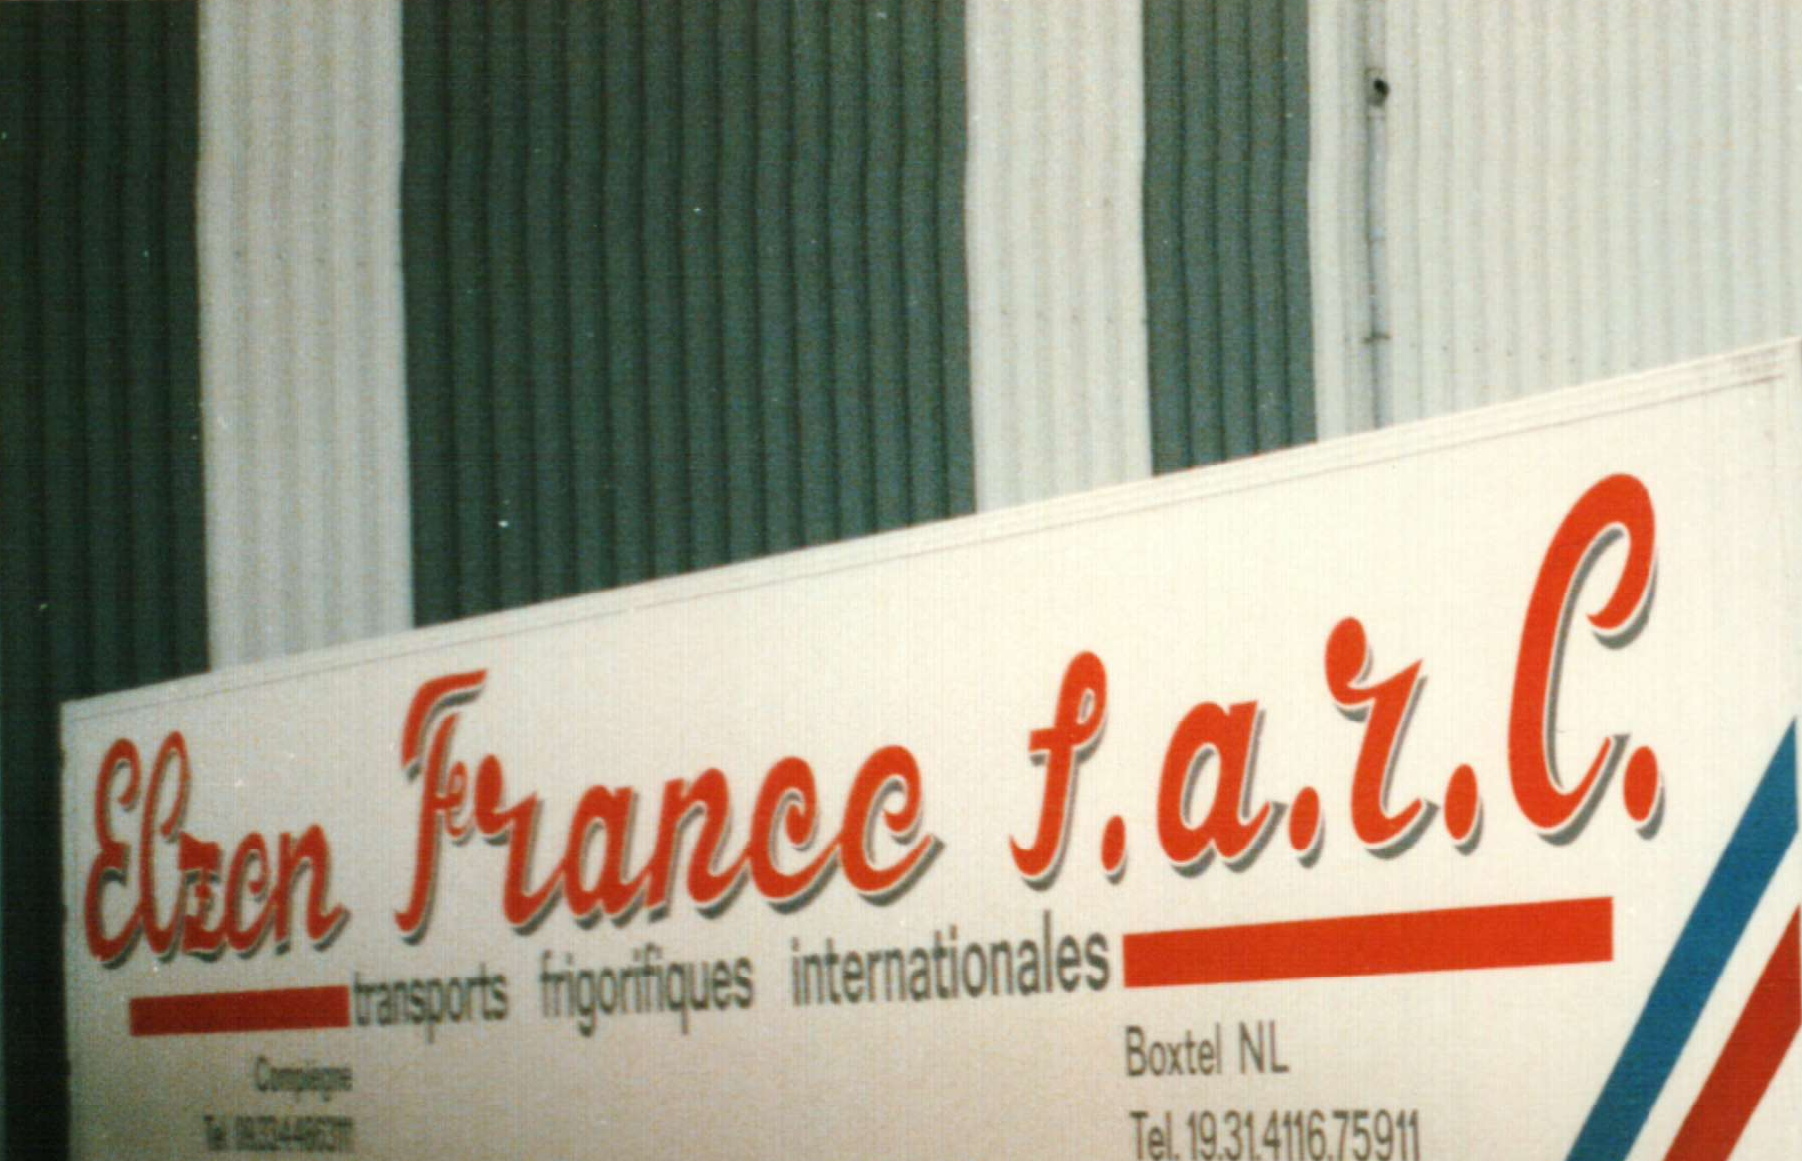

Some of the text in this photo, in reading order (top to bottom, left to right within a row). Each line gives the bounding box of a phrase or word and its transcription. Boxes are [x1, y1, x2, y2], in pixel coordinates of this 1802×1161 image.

[394, 668, 944, 940] France
[352, 908, 1112, 1044] transports frigorifiques internationales
[1124, 1019, 1290, 1077] Boxtel NL
